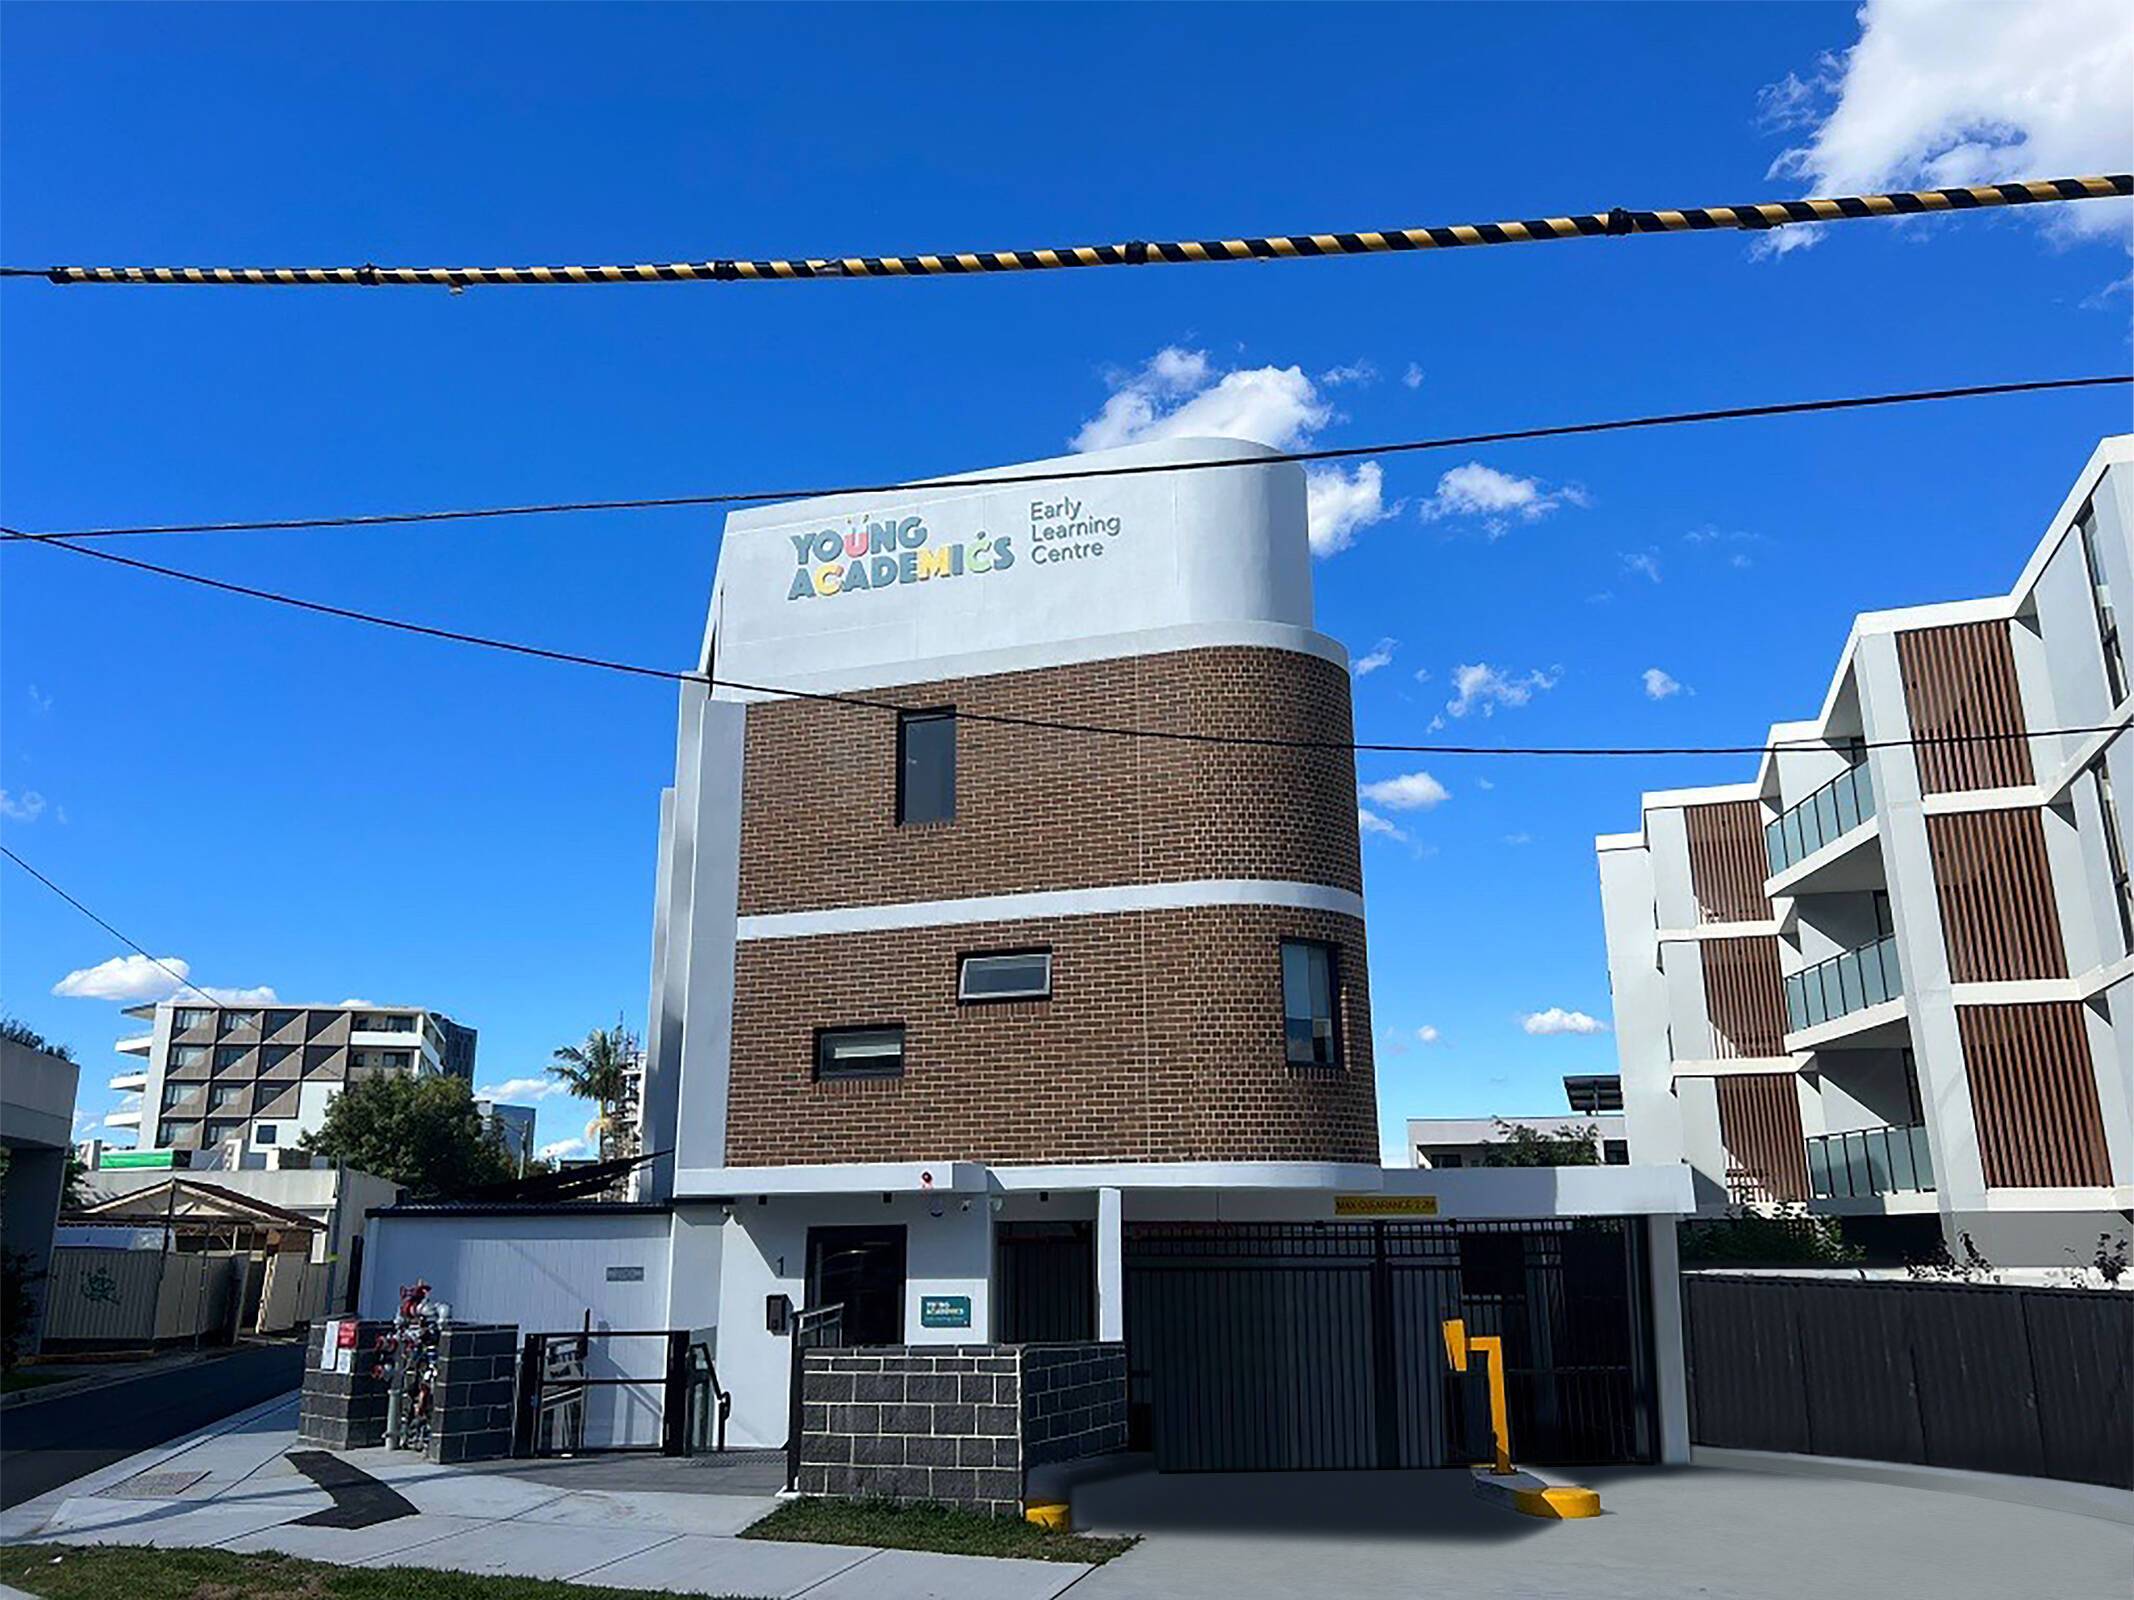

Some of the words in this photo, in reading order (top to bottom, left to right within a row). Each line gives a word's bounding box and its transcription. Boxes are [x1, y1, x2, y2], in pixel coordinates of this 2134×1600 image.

[1031, 496, 1082, 521] Early
[789, 515, 928, 565] YOUNG
[1032, 515, 1121, 542] Learning
[1031, 542, 1104, 565] Centre
[787, 533, 1015, 601] ACADEMICS
[776, 1256, 784, 1276] 1
